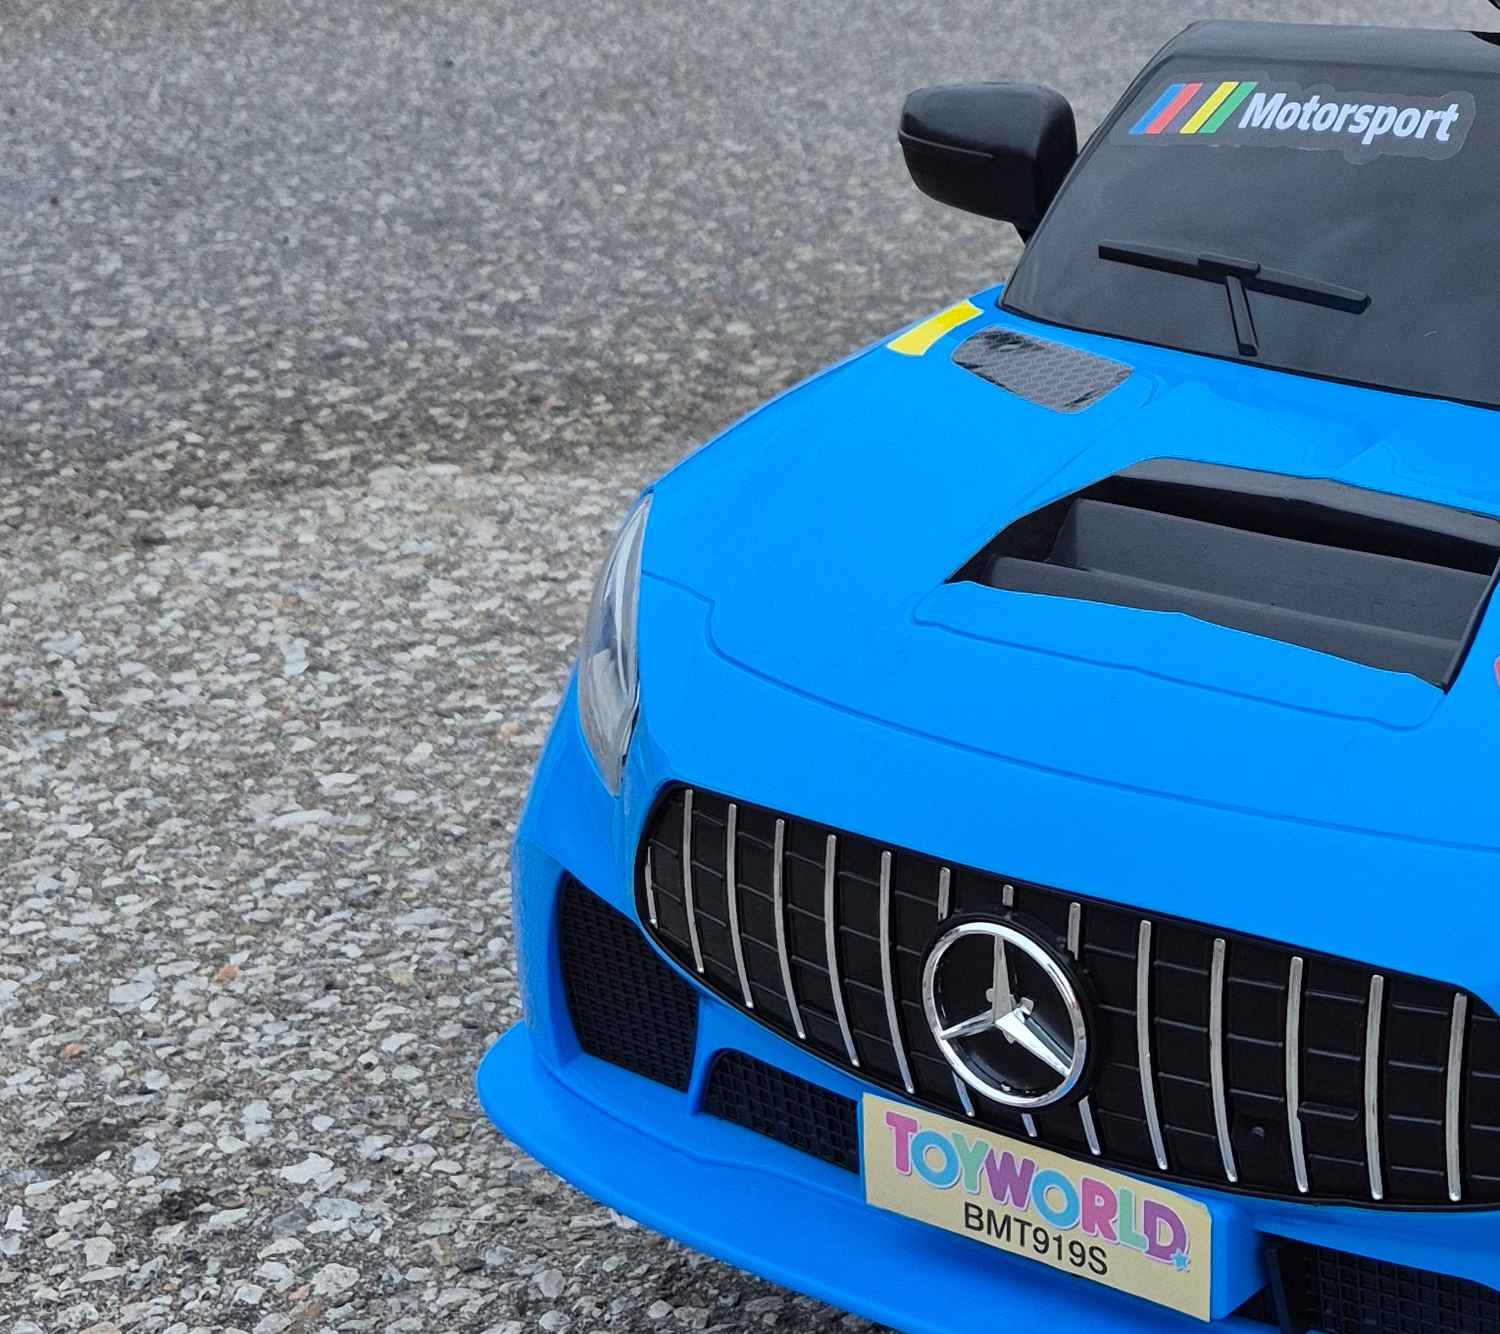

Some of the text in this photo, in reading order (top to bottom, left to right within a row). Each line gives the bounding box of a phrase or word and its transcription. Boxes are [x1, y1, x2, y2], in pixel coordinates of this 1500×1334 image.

[1238, 92, 1460, 145] Motorsport
[884, 1110, 1190, 1267] TOYWORLD
[964, 1201, 1108, 1276] BMT919S
